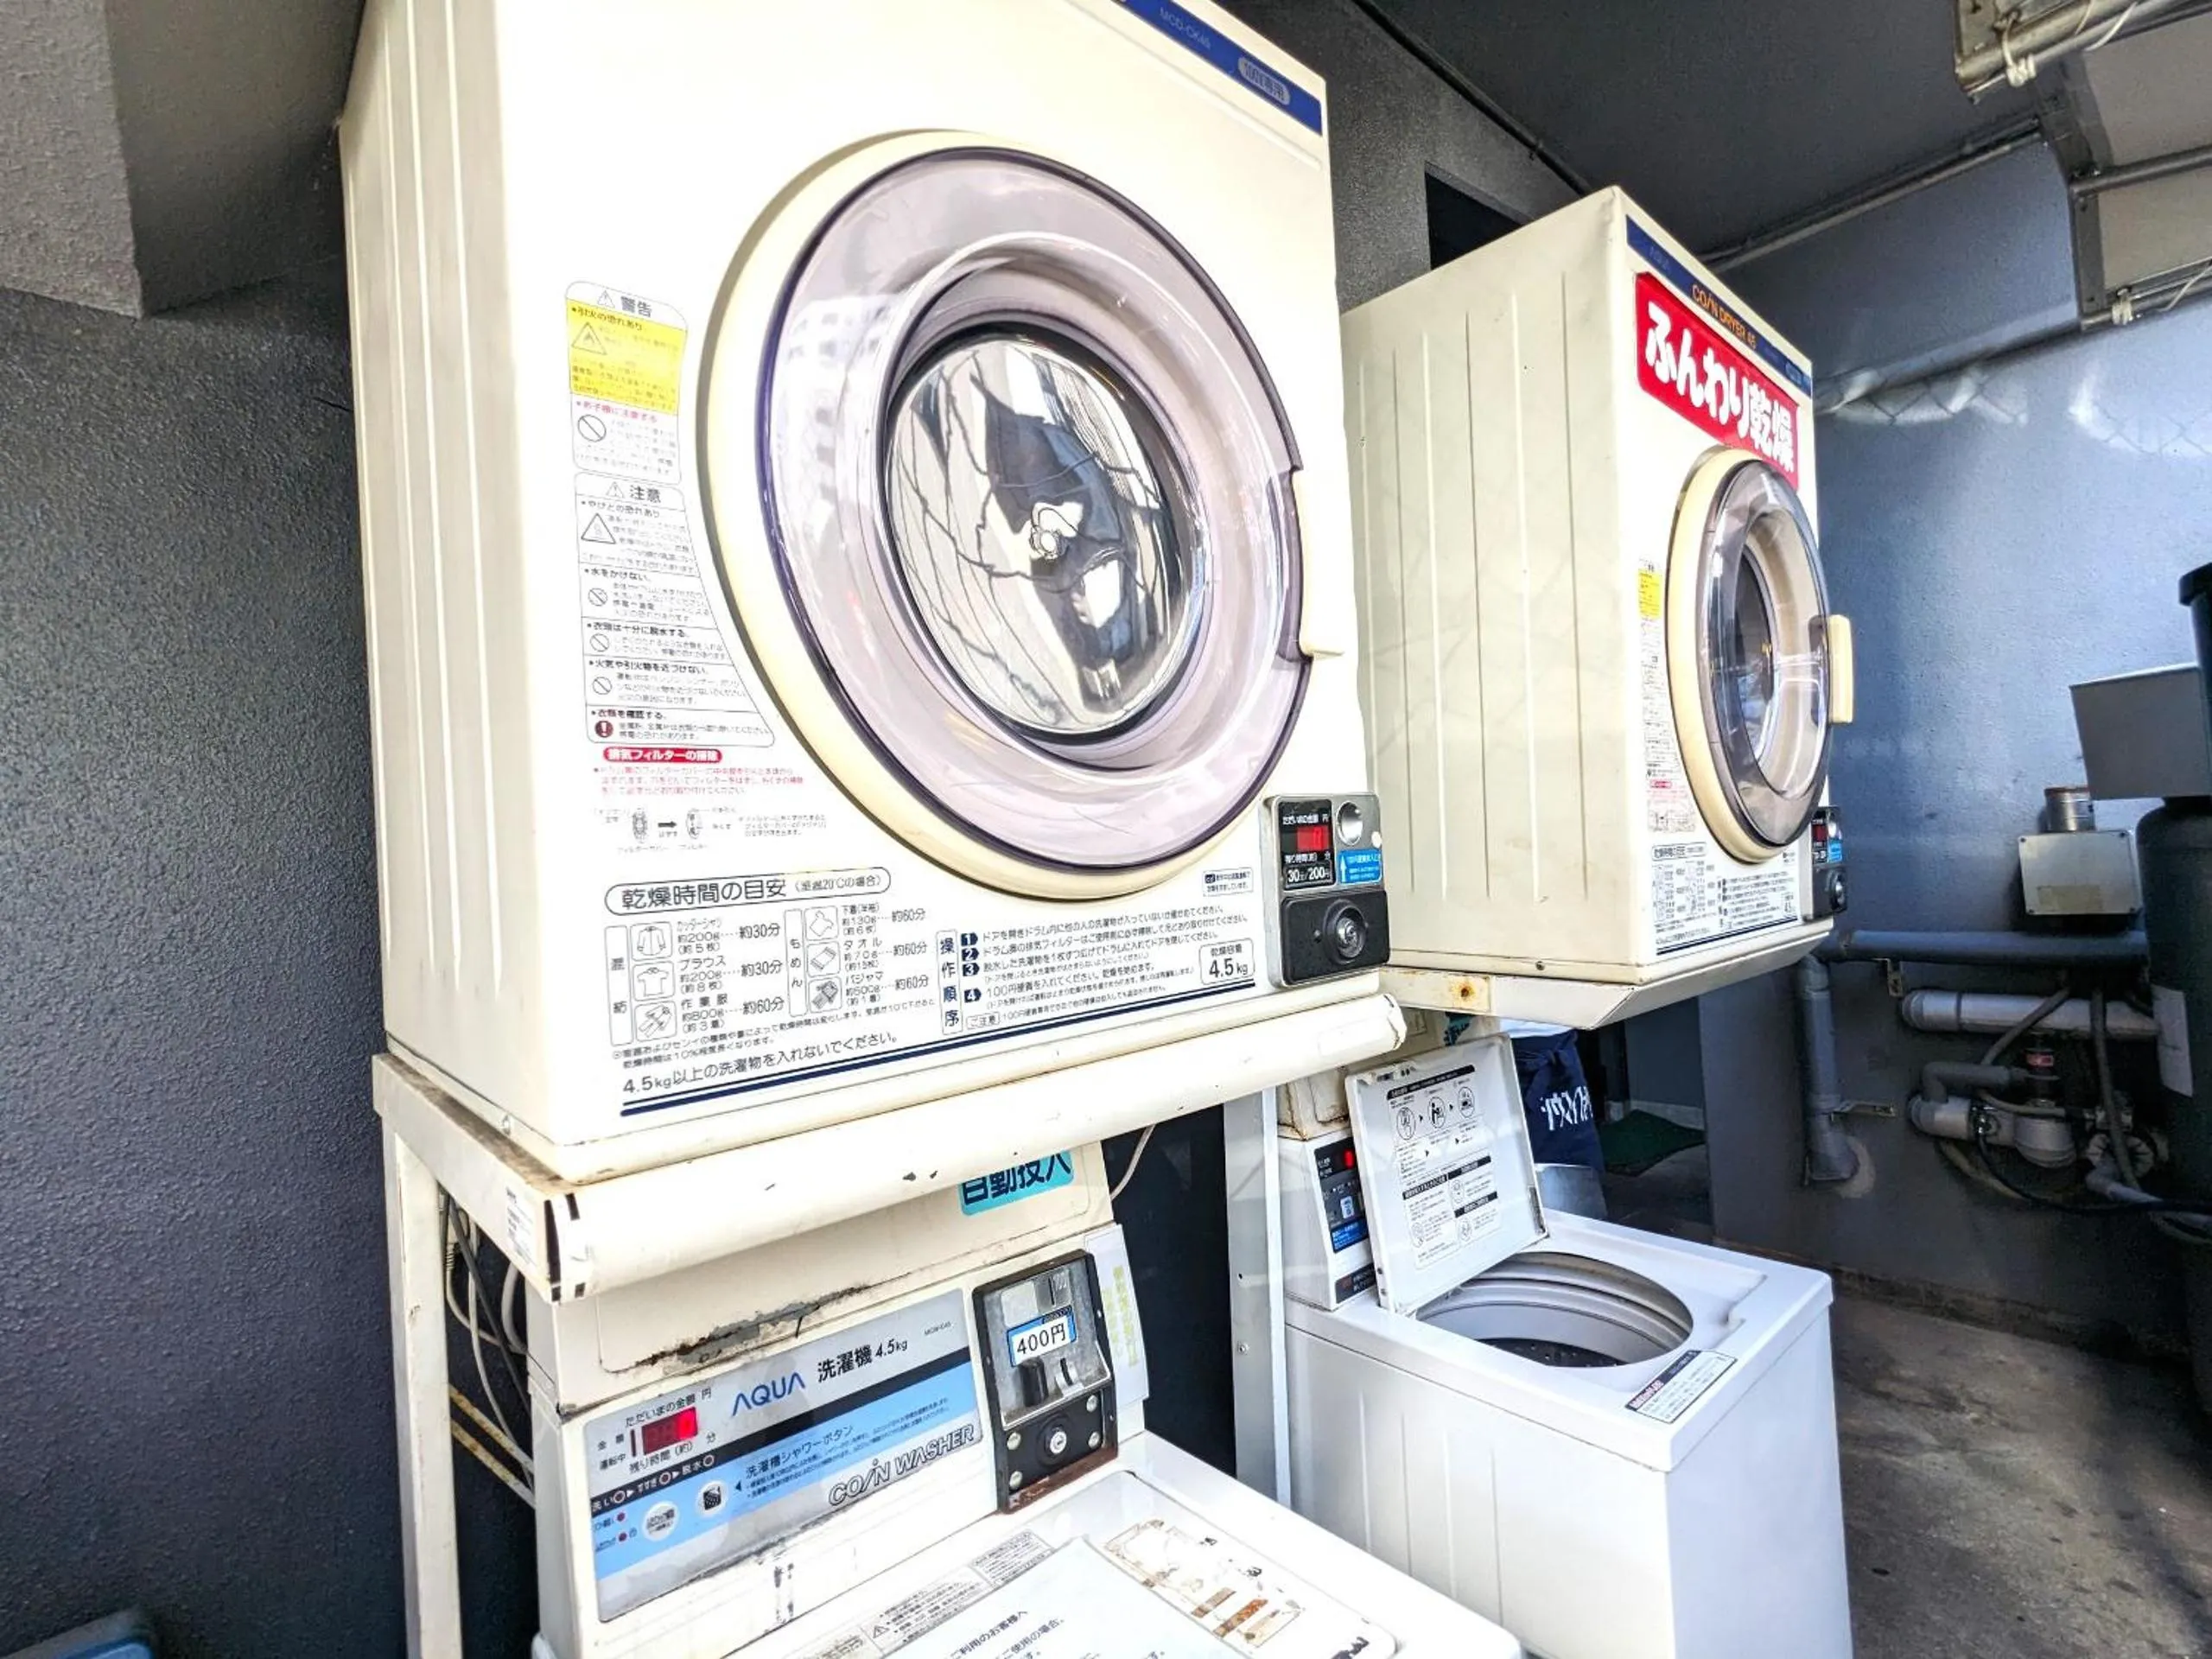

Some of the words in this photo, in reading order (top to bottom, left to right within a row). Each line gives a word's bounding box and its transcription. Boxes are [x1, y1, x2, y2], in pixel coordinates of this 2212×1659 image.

[620, 296, 652, 318] 警告
[1645, 301, 1795, 473] ふんわり乾燥
[629, 485, 661, 504] 注意
[621, 880, 788, 911] 乾燥時間の目安
[739, 922, 781, 939] 約30分
[741, 959, 783, 977] 約30分
[939, 937, 961, 1027] 操作順序
[742, 996, 785, 1015] 約60分
[968, 1014, 997, 1027] ご注意
[622, 1032, 898, 1094] 4.5kg以上の洗濯物を入れないでください。
[1015, 1322, 1066, 1356] 400円
[817, 1343, 874, 1383] 洗濯機
[874, 1338, 909, 1360] 4.5kg
[625, 1393, 696, 1428] ただいまの金額
[701, 1387, 712, 1401] 円
[730, 1371, 807, 1417] AQUA
[828, 1458, 891, 1507] COIN
[893, 1423, 976, 1477] WASHER
